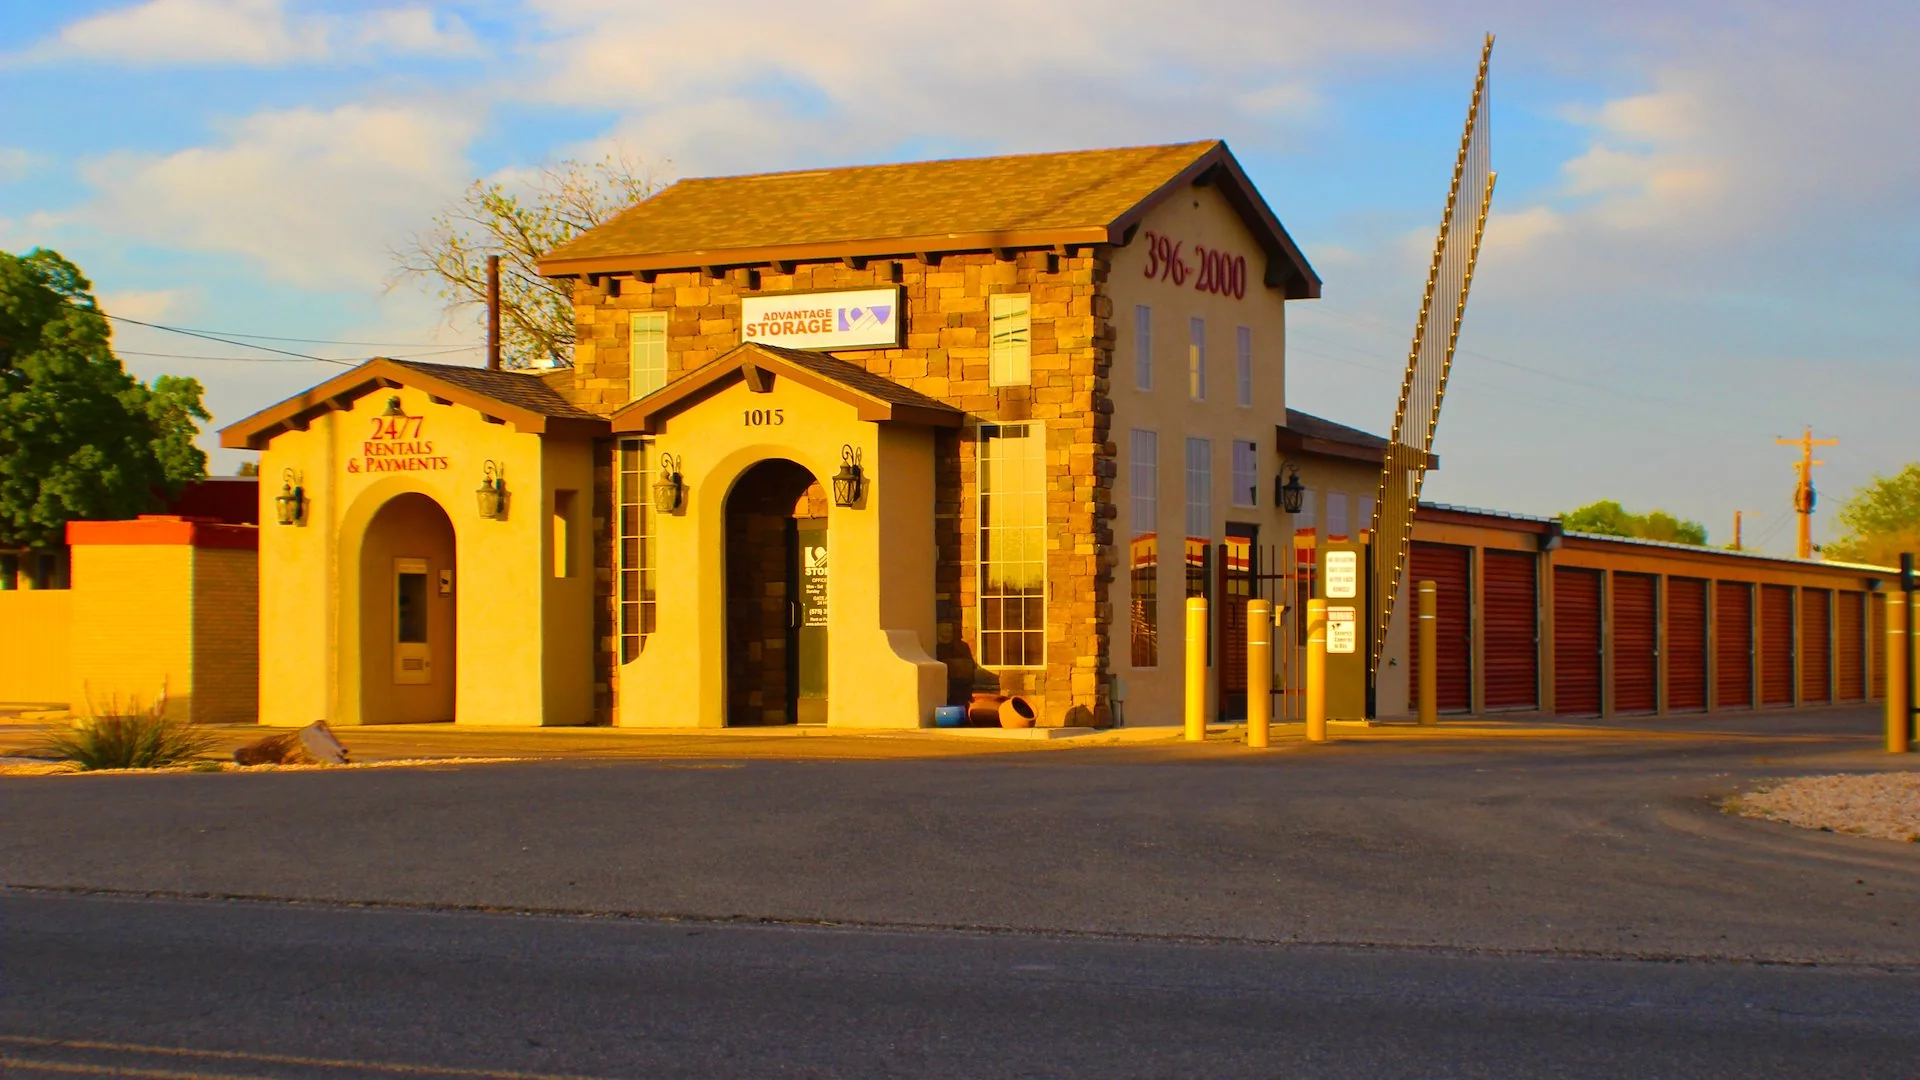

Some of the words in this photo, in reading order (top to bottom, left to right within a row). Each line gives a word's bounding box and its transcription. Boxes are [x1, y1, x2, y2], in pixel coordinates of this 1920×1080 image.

[763, 308, 832, 321] ADVANTAGE
[746, 319, 832, 337] STORAGE
[744, 409, 784, 426] 1015
[371, 415, 424, 440] 24/7
[364, 441, 432, 456] RENTALS
[347, 458, 360, 473] &
[366, 456, 448, 472] PAYMENTS
